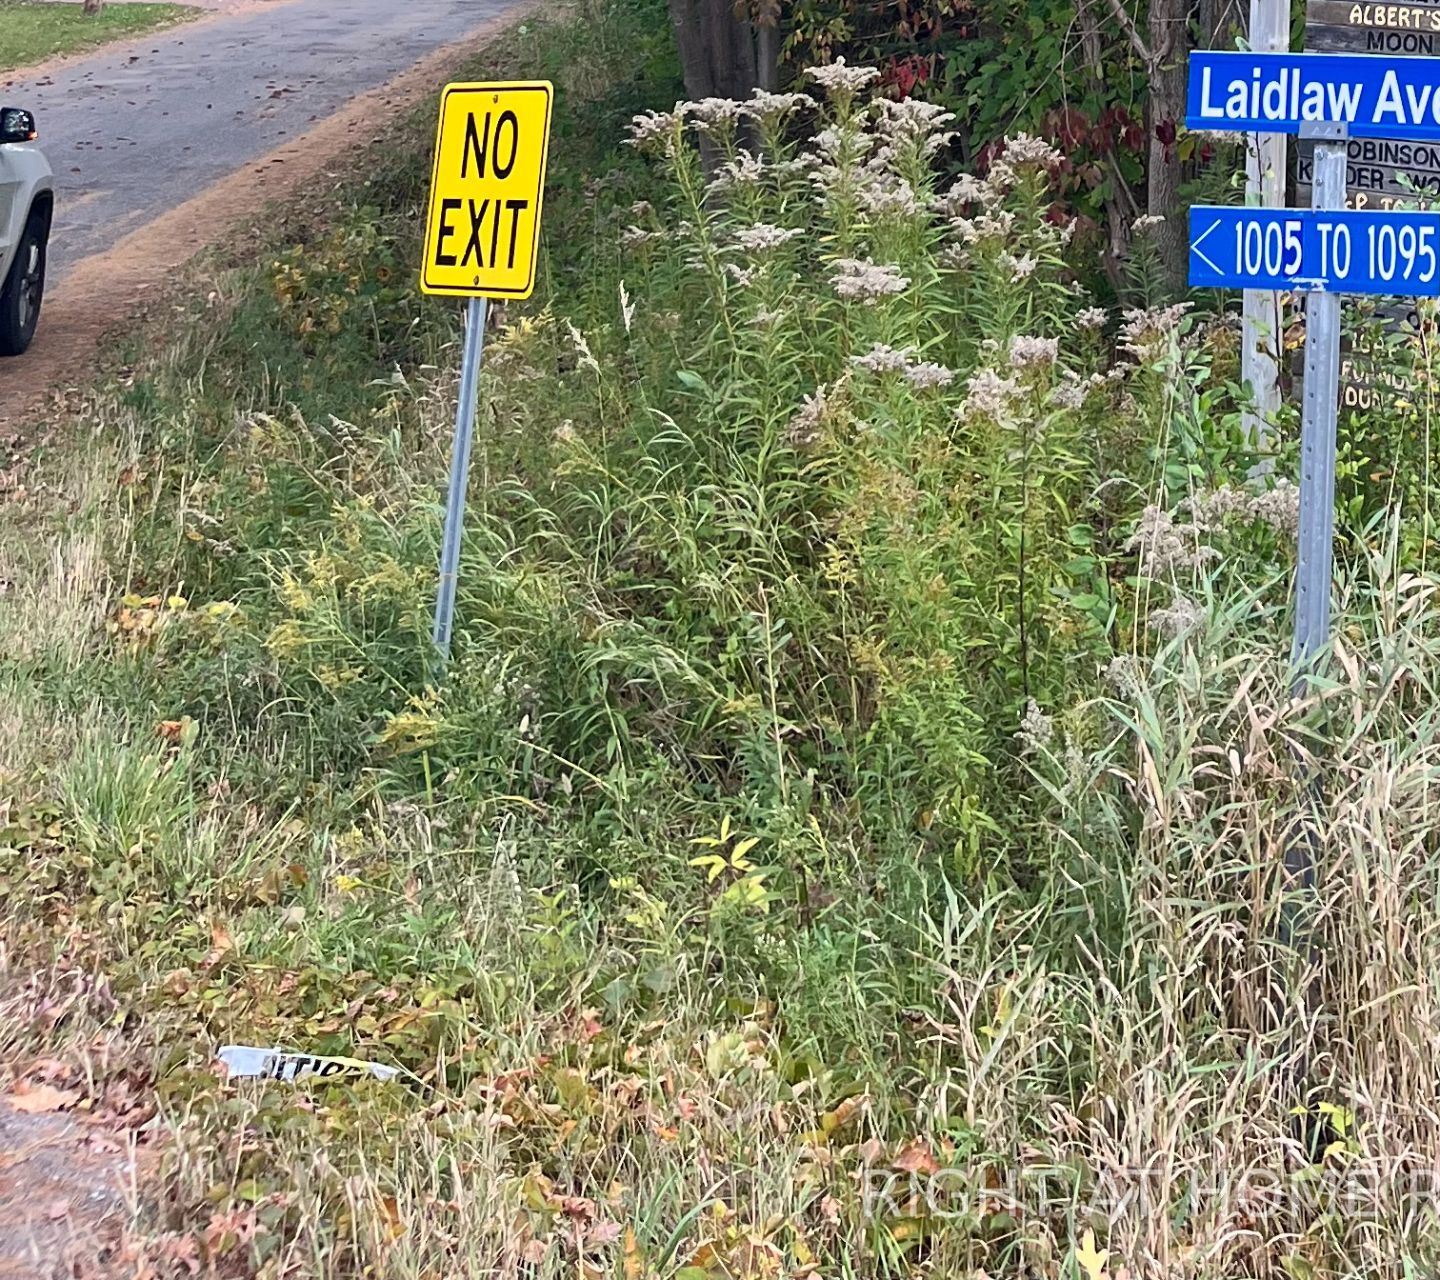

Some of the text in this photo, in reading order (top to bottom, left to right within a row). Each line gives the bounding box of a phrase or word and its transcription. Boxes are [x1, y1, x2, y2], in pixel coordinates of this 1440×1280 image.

[1366, 31, 1433, 54] MOON
[1200, 65, 1364, 123] Laidlaw
[460, 109, 519, 180] NO
[435, 198, 529, 269] EXIT
[1235, 219, 1437, 283] 1005 TO 1095
